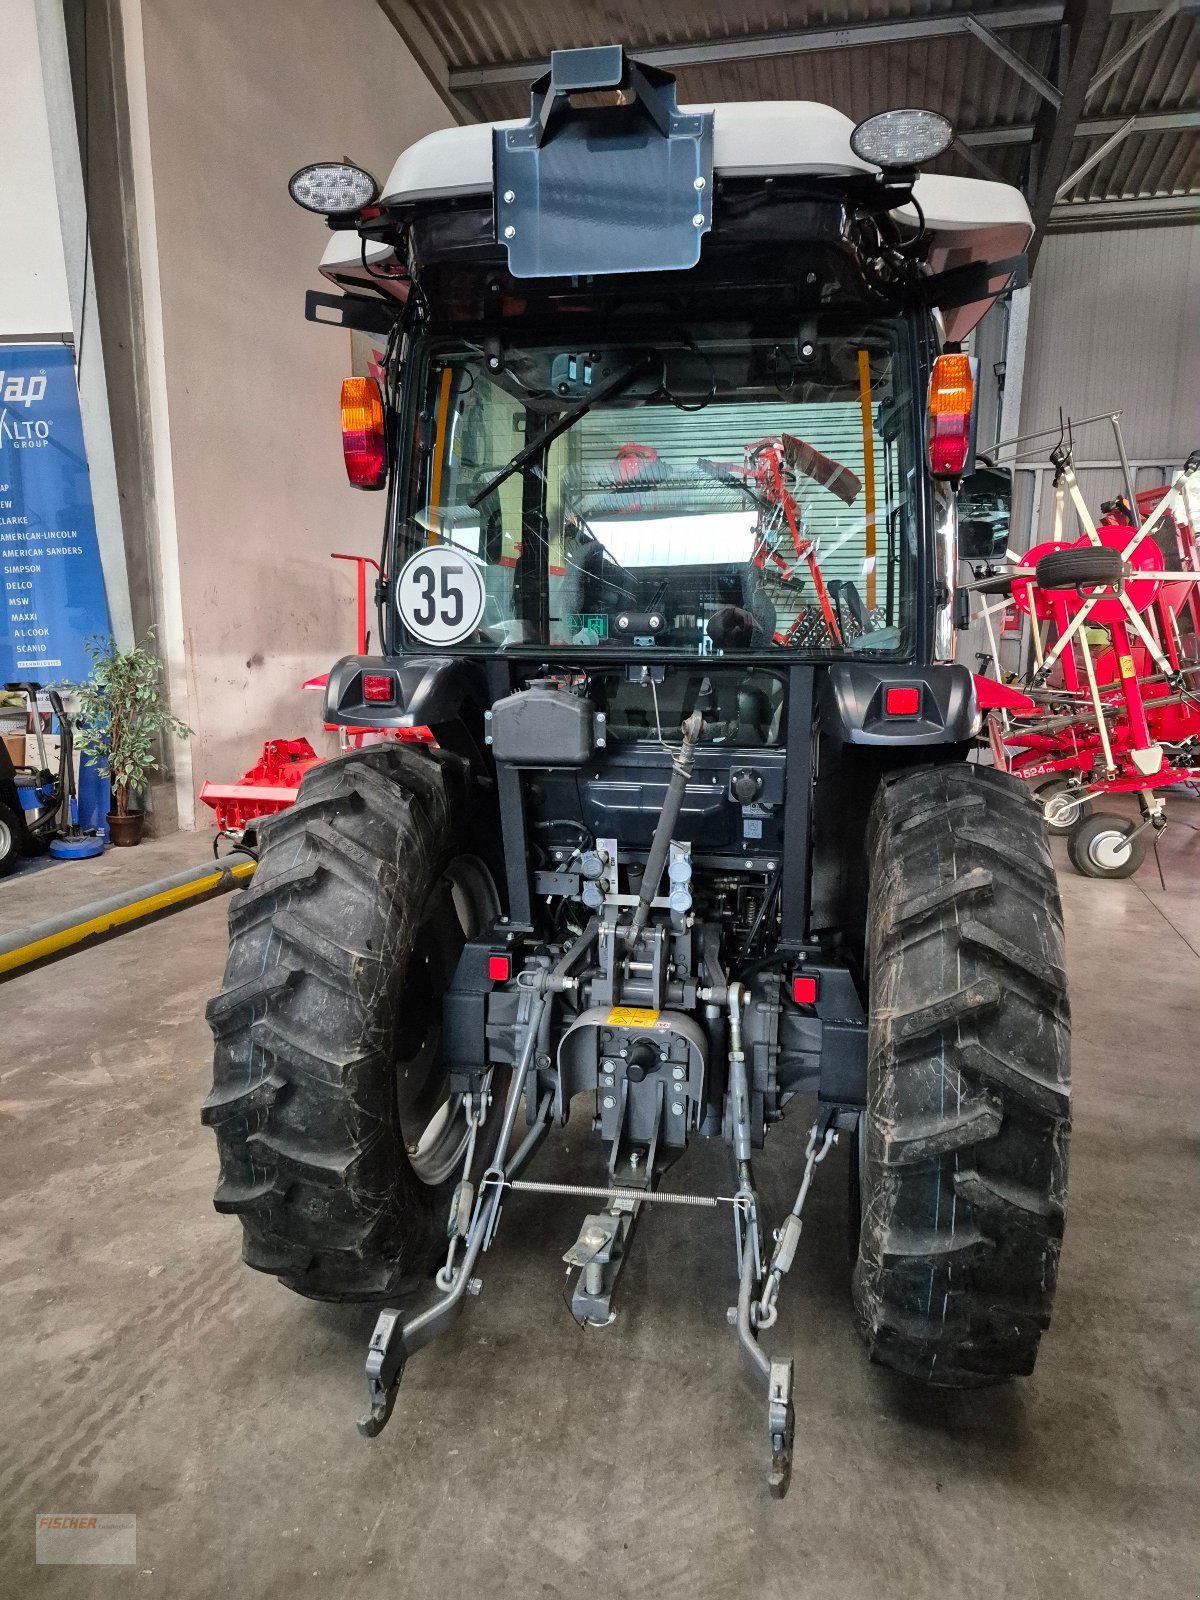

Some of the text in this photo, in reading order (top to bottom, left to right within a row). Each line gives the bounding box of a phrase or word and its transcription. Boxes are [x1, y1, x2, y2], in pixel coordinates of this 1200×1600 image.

[0, 371, 47, 408] ap
[14, 441, 49, 449] GROUP
[0, 483, 9, 492] AP
[0, 500, 12, 509] EW
[0, 530, 77, 541] AMERICAN-LINCOLN
[2, 546, 83, 558] AMERICAN SANDERS
[4, 564, 41, 574] SIMPSON
[6, 581, 33, 590] DELCO
[412, 565, 464, 627] 35
[9, 598, 29, 606] MSW
[11, 613, 38, 622] MAXXI
[27, 627, 50, 637] COOK
[16, 644, 47, 653] SCANIO
[1023, 766, 1045, 778] 524
